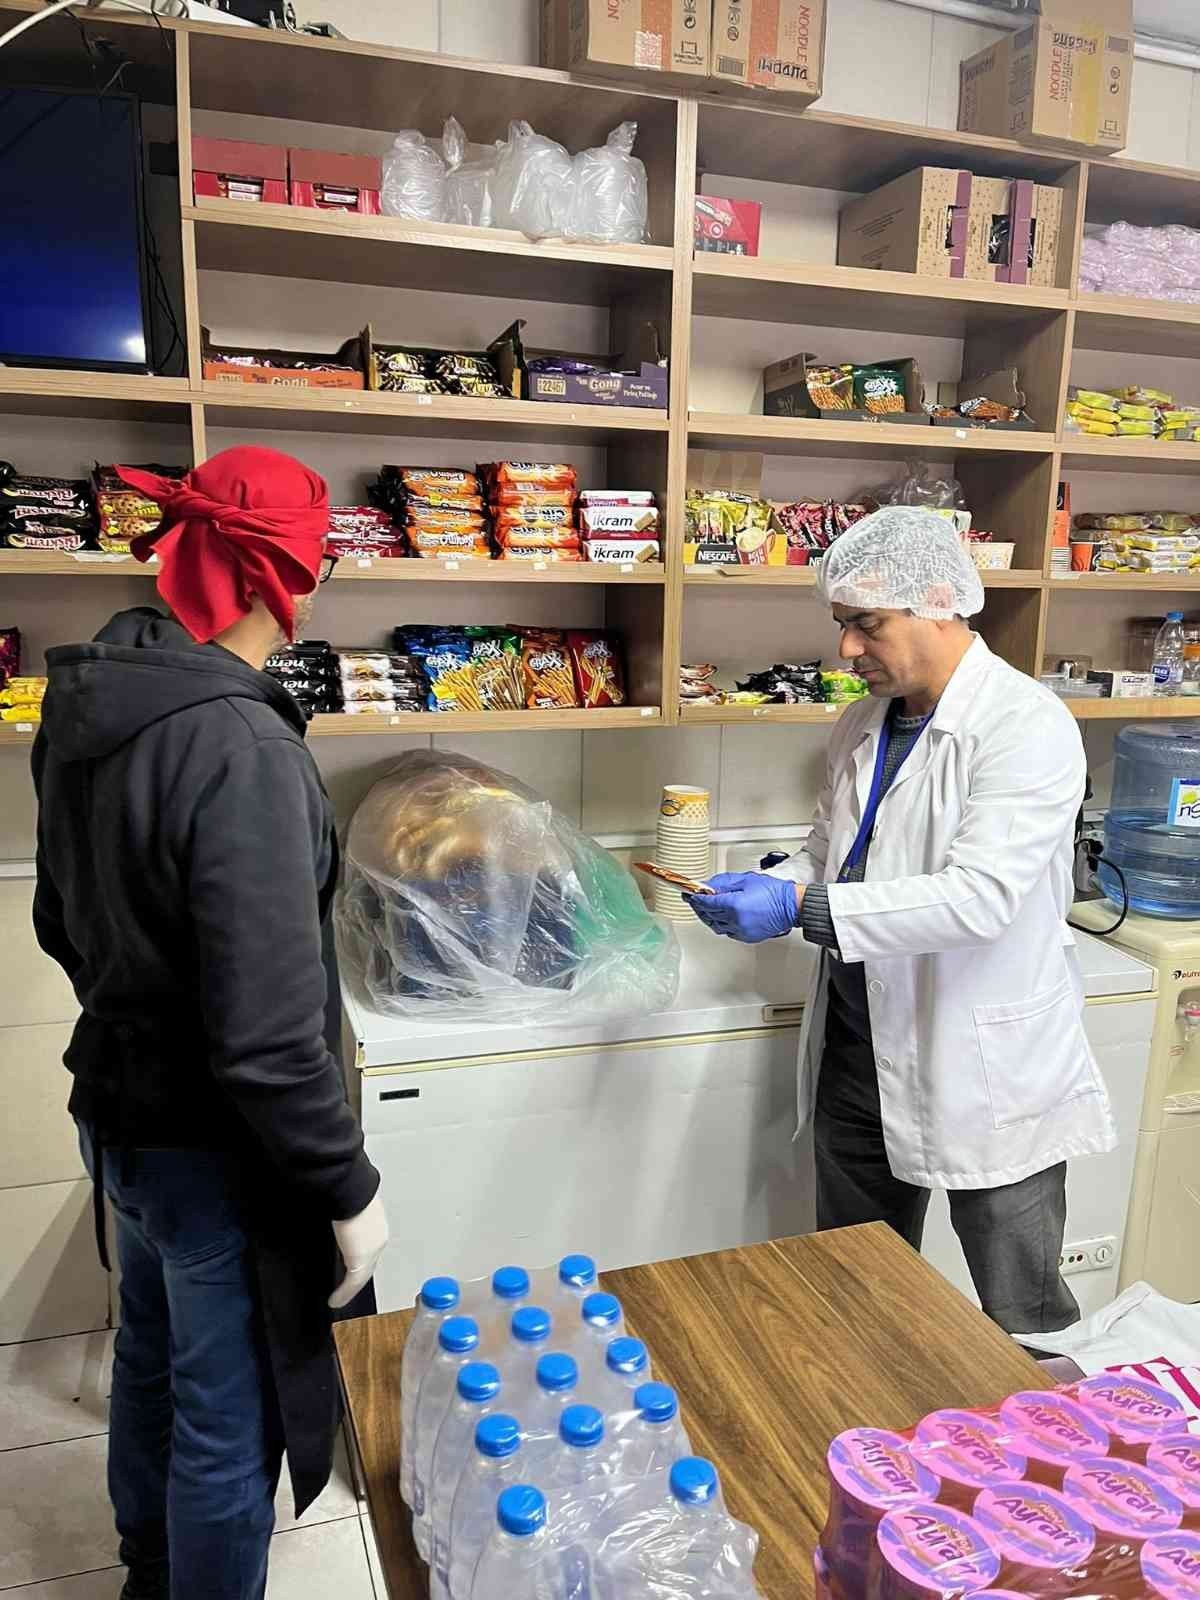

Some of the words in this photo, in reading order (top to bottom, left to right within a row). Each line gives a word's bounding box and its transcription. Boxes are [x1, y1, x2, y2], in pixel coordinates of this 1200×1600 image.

[797, 5, 810, 63] NOODLE
[1049, 48, 1063, 101] NOODLE
[592, 513, 633, 527] ikram
[593, 547, 635, 559] ikram
[1015, 1403, 1093, 1448] Ayran
[1092, 1388, 1173, 1419] Ayran
[851, 1437, 920, 1495] Ayran
[936, 1422, 1009, 1473] Ayran
[1082, 1470, 1168, 1520] Ayran
[903, 1513, 979, 1576] Ayran
[992, 1495, 1083, 1548] Ayran
